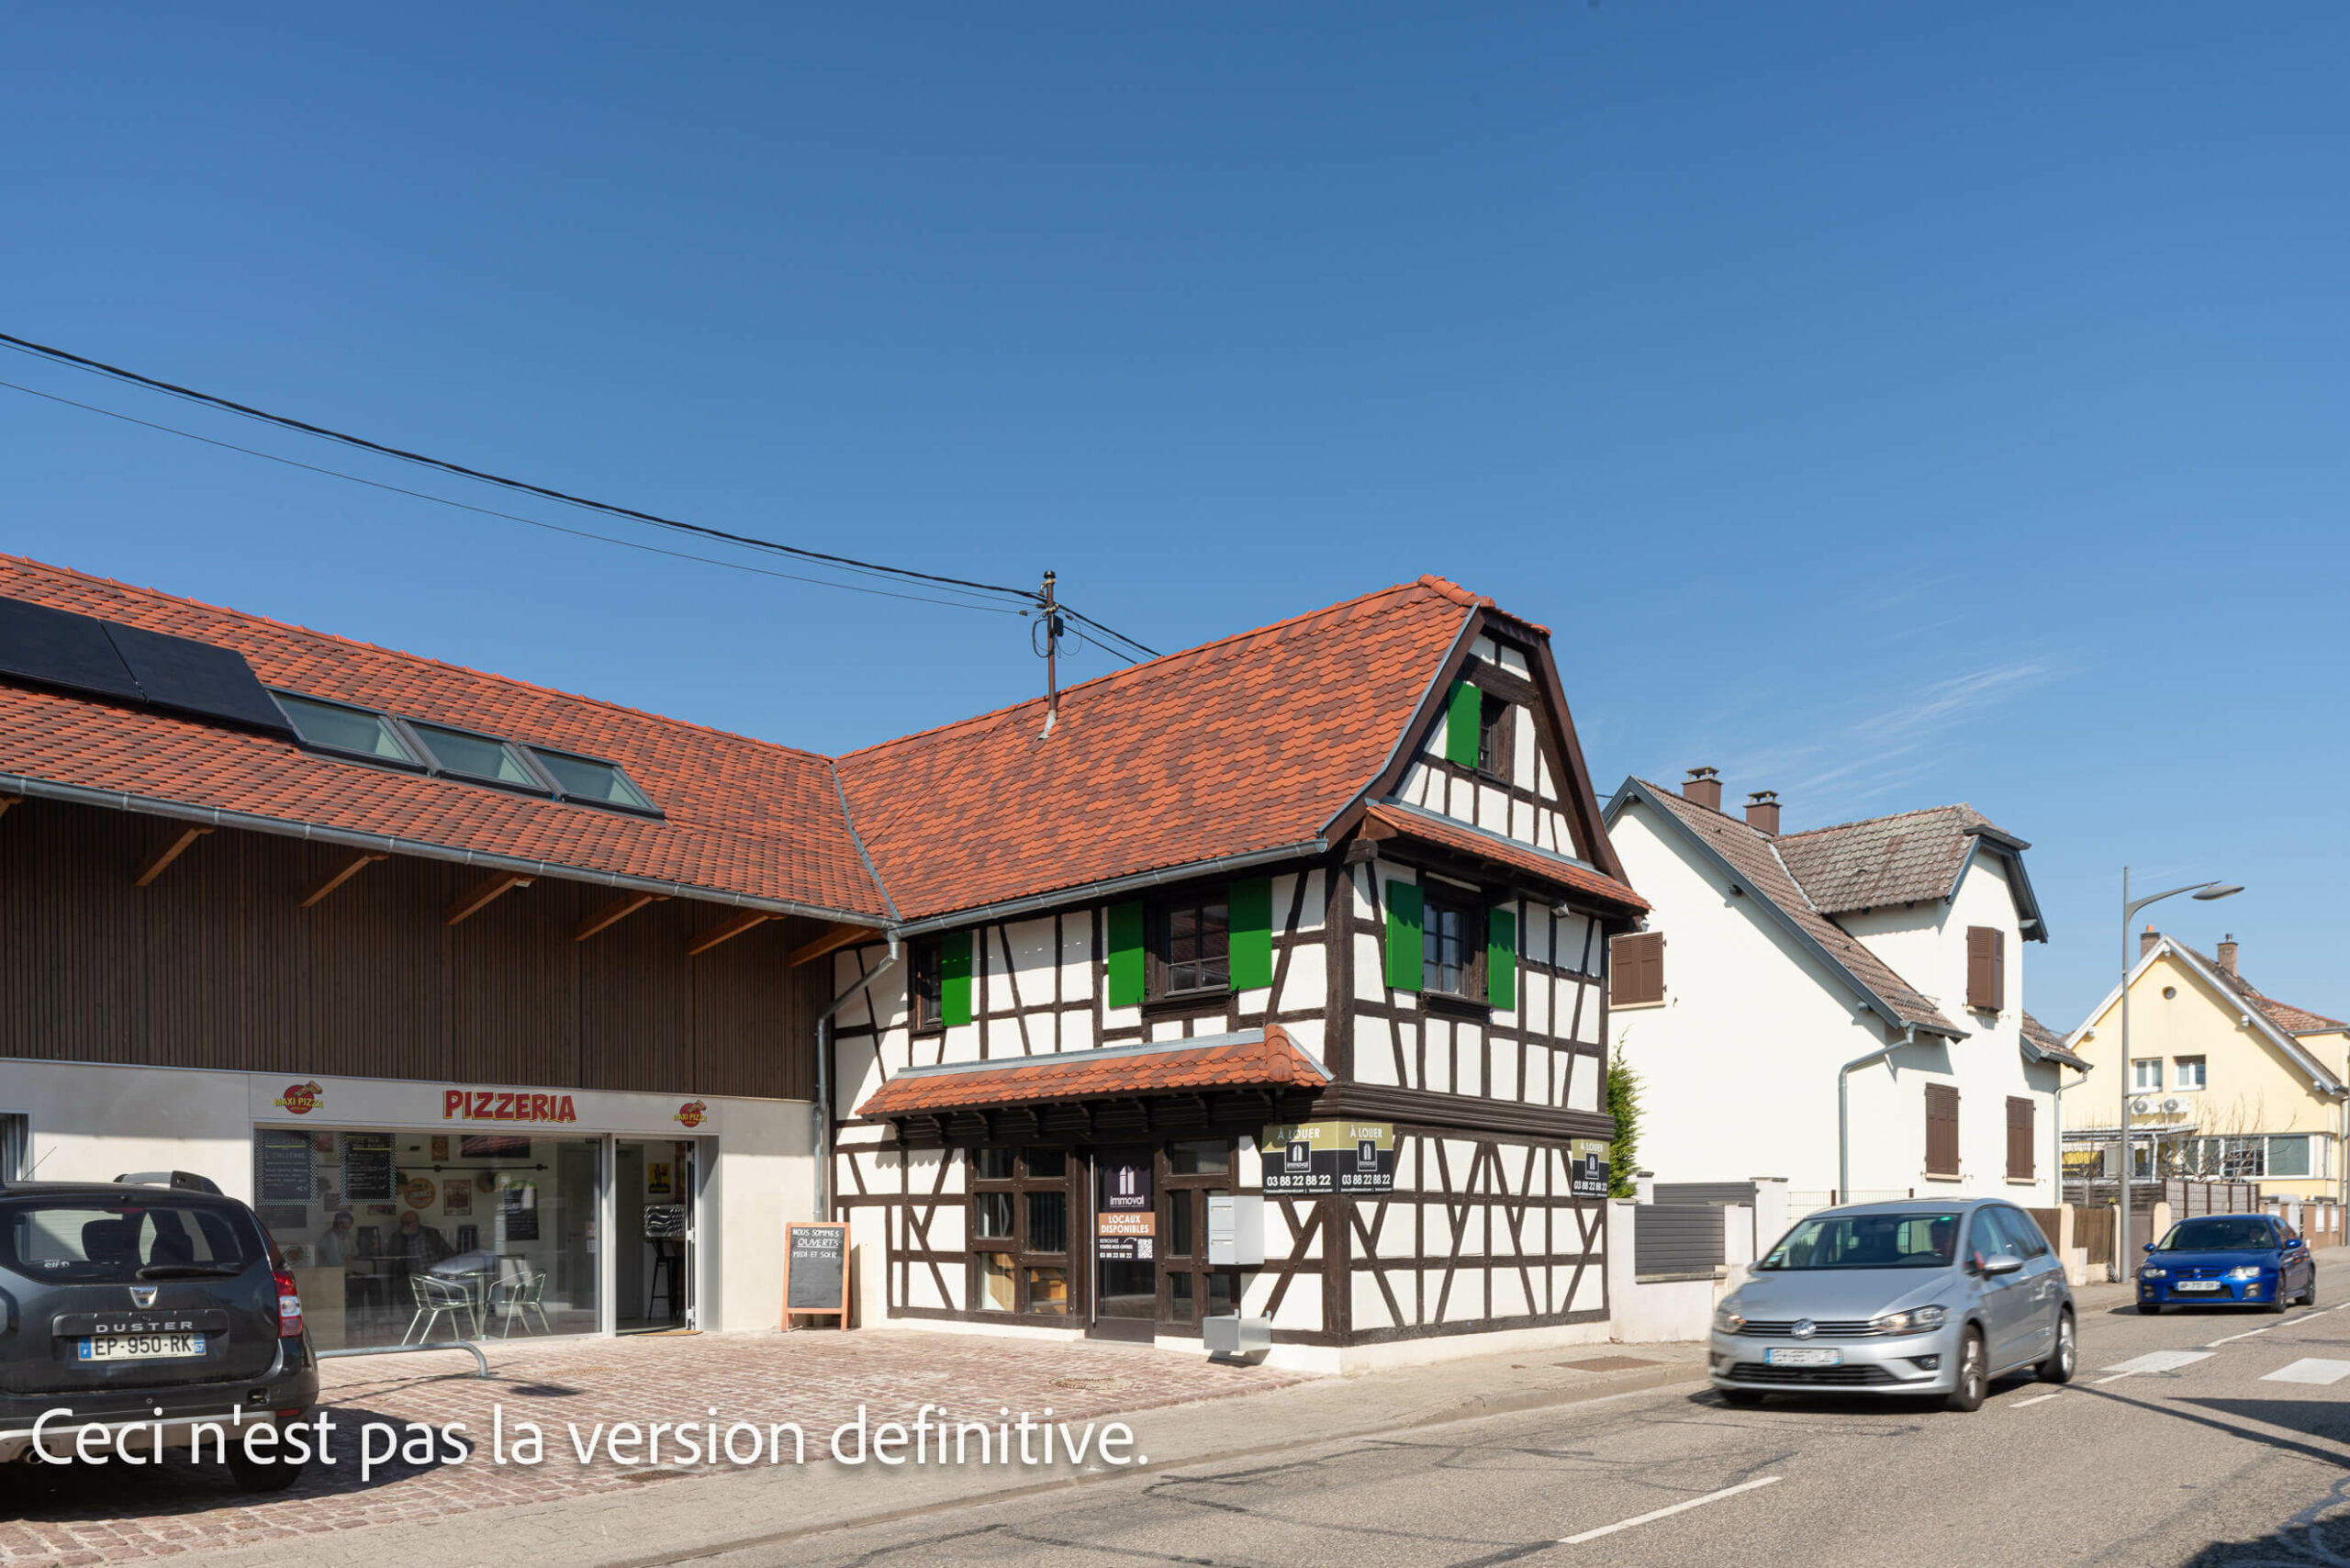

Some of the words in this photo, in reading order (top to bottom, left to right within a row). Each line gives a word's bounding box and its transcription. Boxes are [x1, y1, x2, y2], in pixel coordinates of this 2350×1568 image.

[274, 1097, 297, 1107] MAXI
[298, 1097, 323, 1109] PIZZA
[442, 1090, 576, 1123] PIZZERIA
[1277, 1127, 1284, 1139] À
[1288, 1128, 1320, 1138] LOUER
[1349, 1125, 1356, 1137] À
[1359, 1128, 1382, 1138] LOUER
[1267, 1176, 1278, 1186] 03
[1280, 1176, 1291, 1186] 88
[1292, 1176, 1304, 1186] 22
[1305, 1175, 1317, 1185] 88
[1318, 1175, 1331, 1185] 22
[1341, 1175, 1351, 1185] 03
[1353, 1174, 1362, 1185] 88
[1363, 1174, 1372, 1184] 22
[1373, 1174, 1382, 1184] 88
[1382, 1174, 1391, 1184] 22
[1574, 1181, 1581, 1190] 03
[1589, 1182, 1595, 1190] 22
[1110, 1195, 1144, 1204] immoval
[1108, 1215, 1140, 1224] LOCAUX
[811, 1229, 839, 1238] SOMMES
[1102, 1225, 1148, 1233] DISPONIBLES
[797, 1238, 839, 1247] OUVERTS
[95, 1321, 193, 1333] DUSTER
[95, 1334, 192, 1356] EP-950-RK
